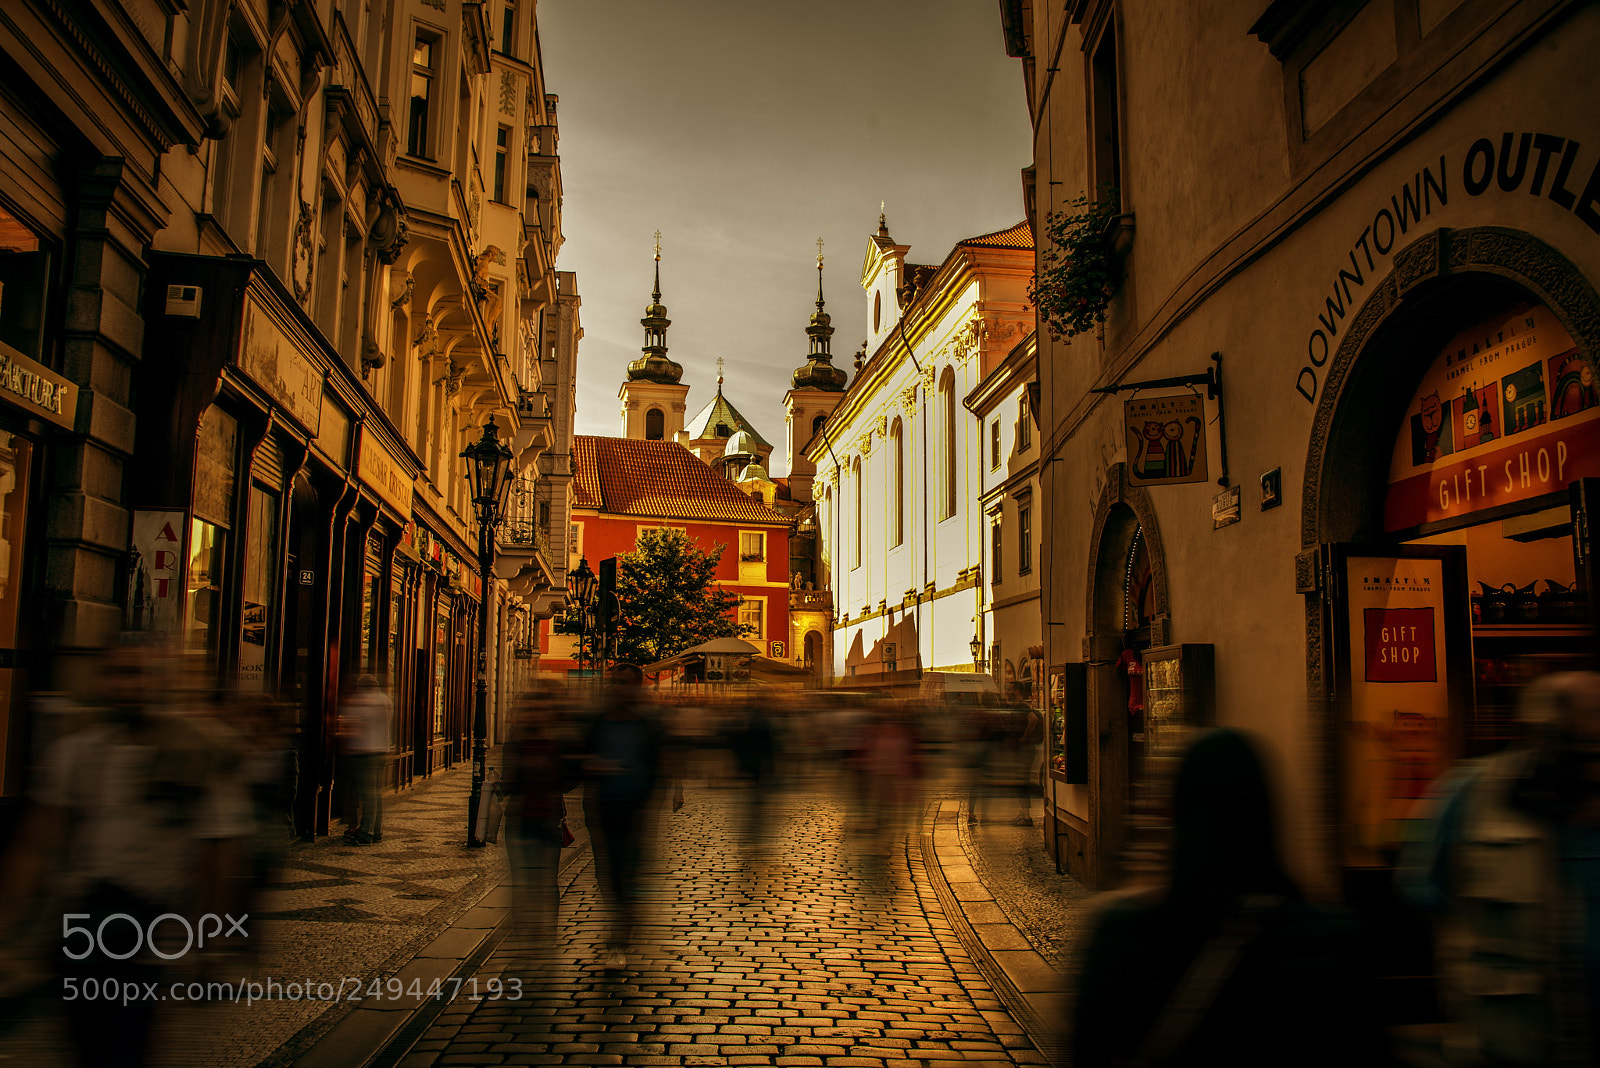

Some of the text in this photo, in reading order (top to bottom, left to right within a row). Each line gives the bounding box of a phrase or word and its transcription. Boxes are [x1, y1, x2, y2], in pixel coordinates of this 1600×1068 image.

[1296, 155, 1448, 404] DOWNTOWN
[1446, 335, 1537, 380] ENAMEL FROM PRAGUE
[1439, 440, 1567, 510] GIFT SHOP
[154, 521, 178, 598] ART
[302, 572, 311, 580] 24
[1381, 626, 1417, 643] GIFT
[1381, 646, 1420, 664] SHOP
